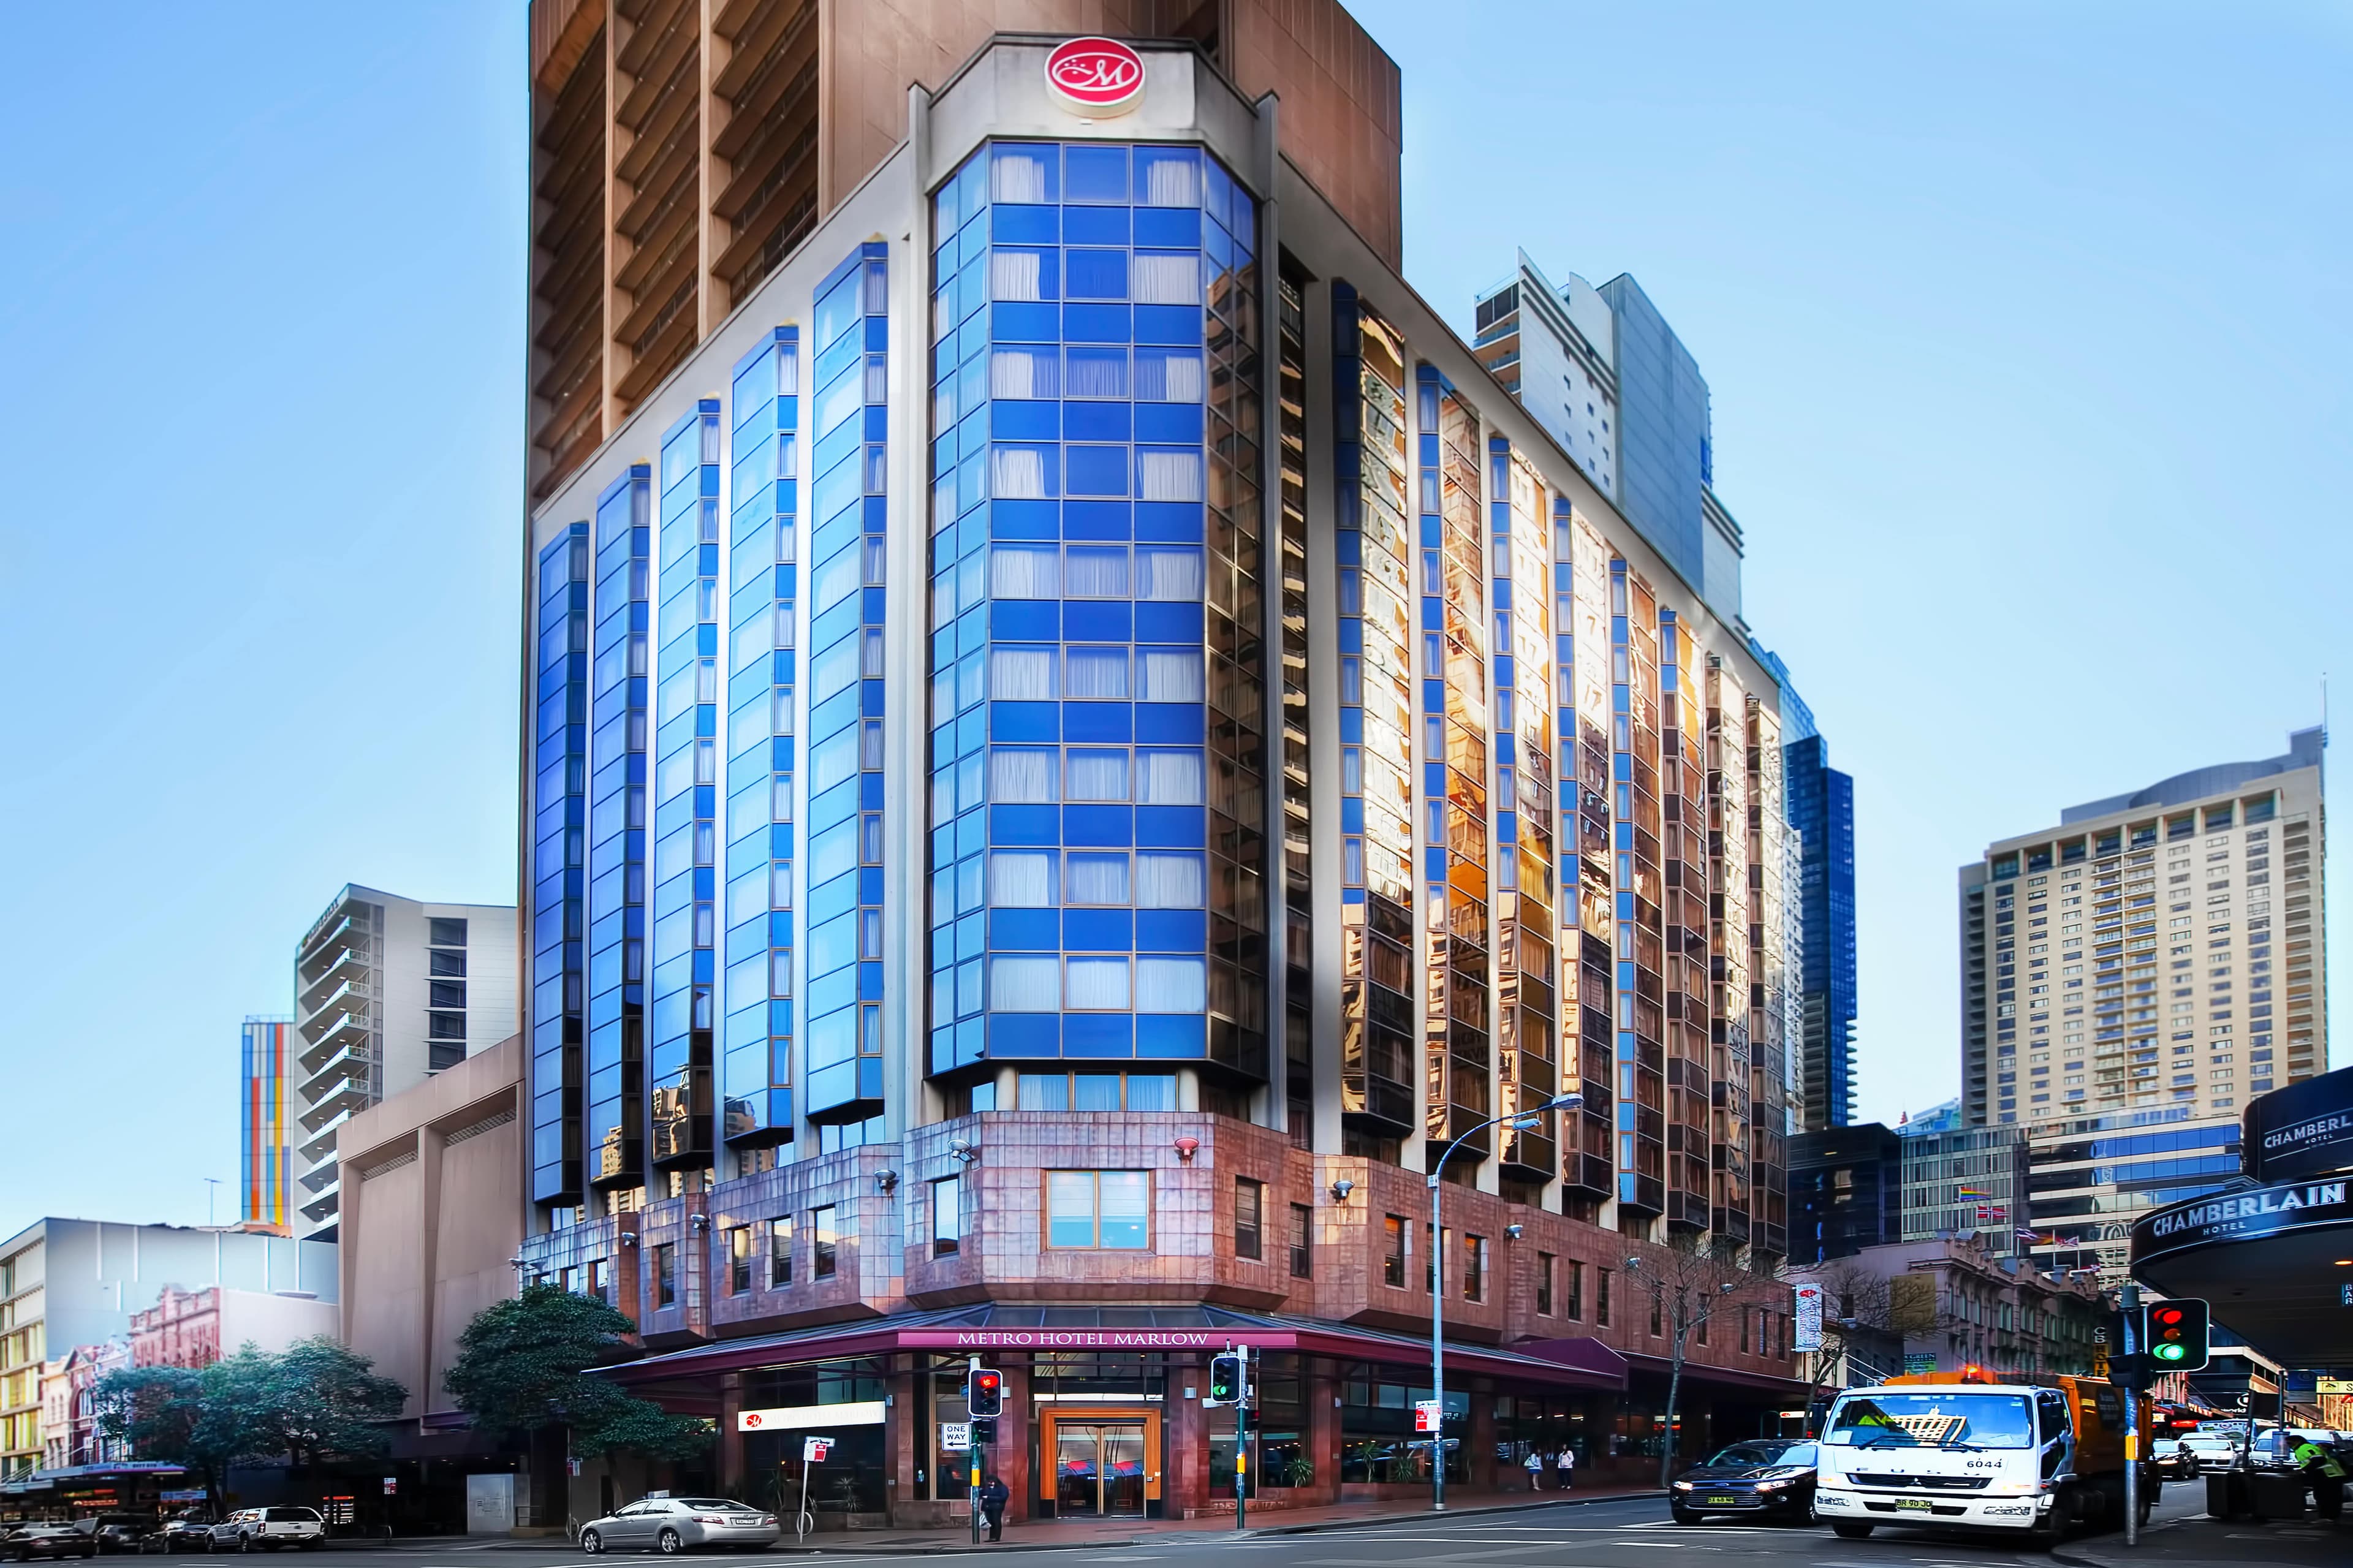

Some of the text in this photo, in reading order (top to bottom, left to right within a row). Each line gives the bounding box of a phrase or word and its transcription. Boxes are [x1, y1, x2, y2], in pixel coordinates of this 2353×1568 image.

[2264, 1115, 2353, 1148] CHAMBERL
[2153, 1183, 2346, 1236] CHAMBERLAIN
[2203, 1221, 2246, 1235] HOTEL
[958, 1333, 1208, 1345] METRO HOTEL MARLOW
[1967, 1460, 2003, 1468] 6044
